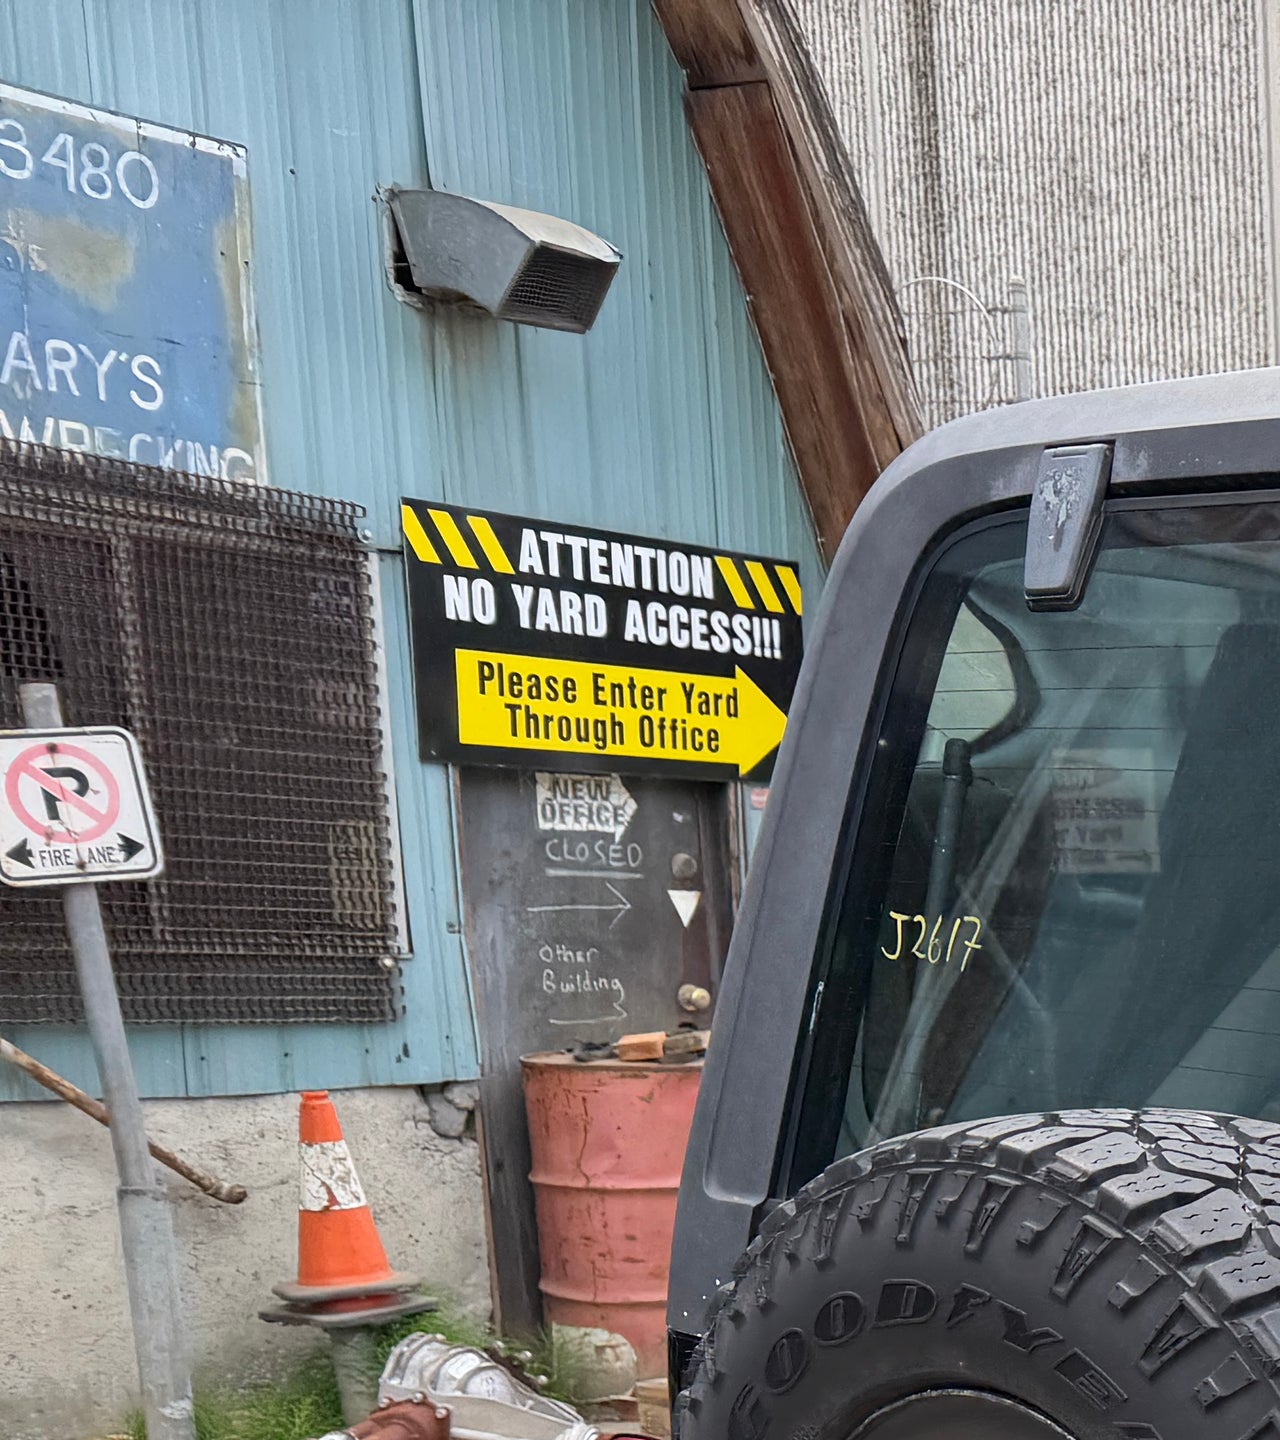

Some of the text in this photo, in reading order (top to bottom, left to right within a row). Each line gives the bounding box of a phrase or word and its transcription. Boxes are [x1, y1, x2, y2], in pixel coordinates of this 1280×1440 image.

[519, 527, 715, 600] ATTENTION
[443, 574, 782, 659] NO YARD ACCESS!!!
[478, 660, 739, 719] Please Enter Yard
[504, 703, 720, 753] Through Office
[552, 776, 611, 799] NEW
[38, 849, 74, 868] FIRE
[545, 839, 643, 867] CLOSED
[881, 911, 983, 972] J2617
[543, 969, 625, 1003] Building
